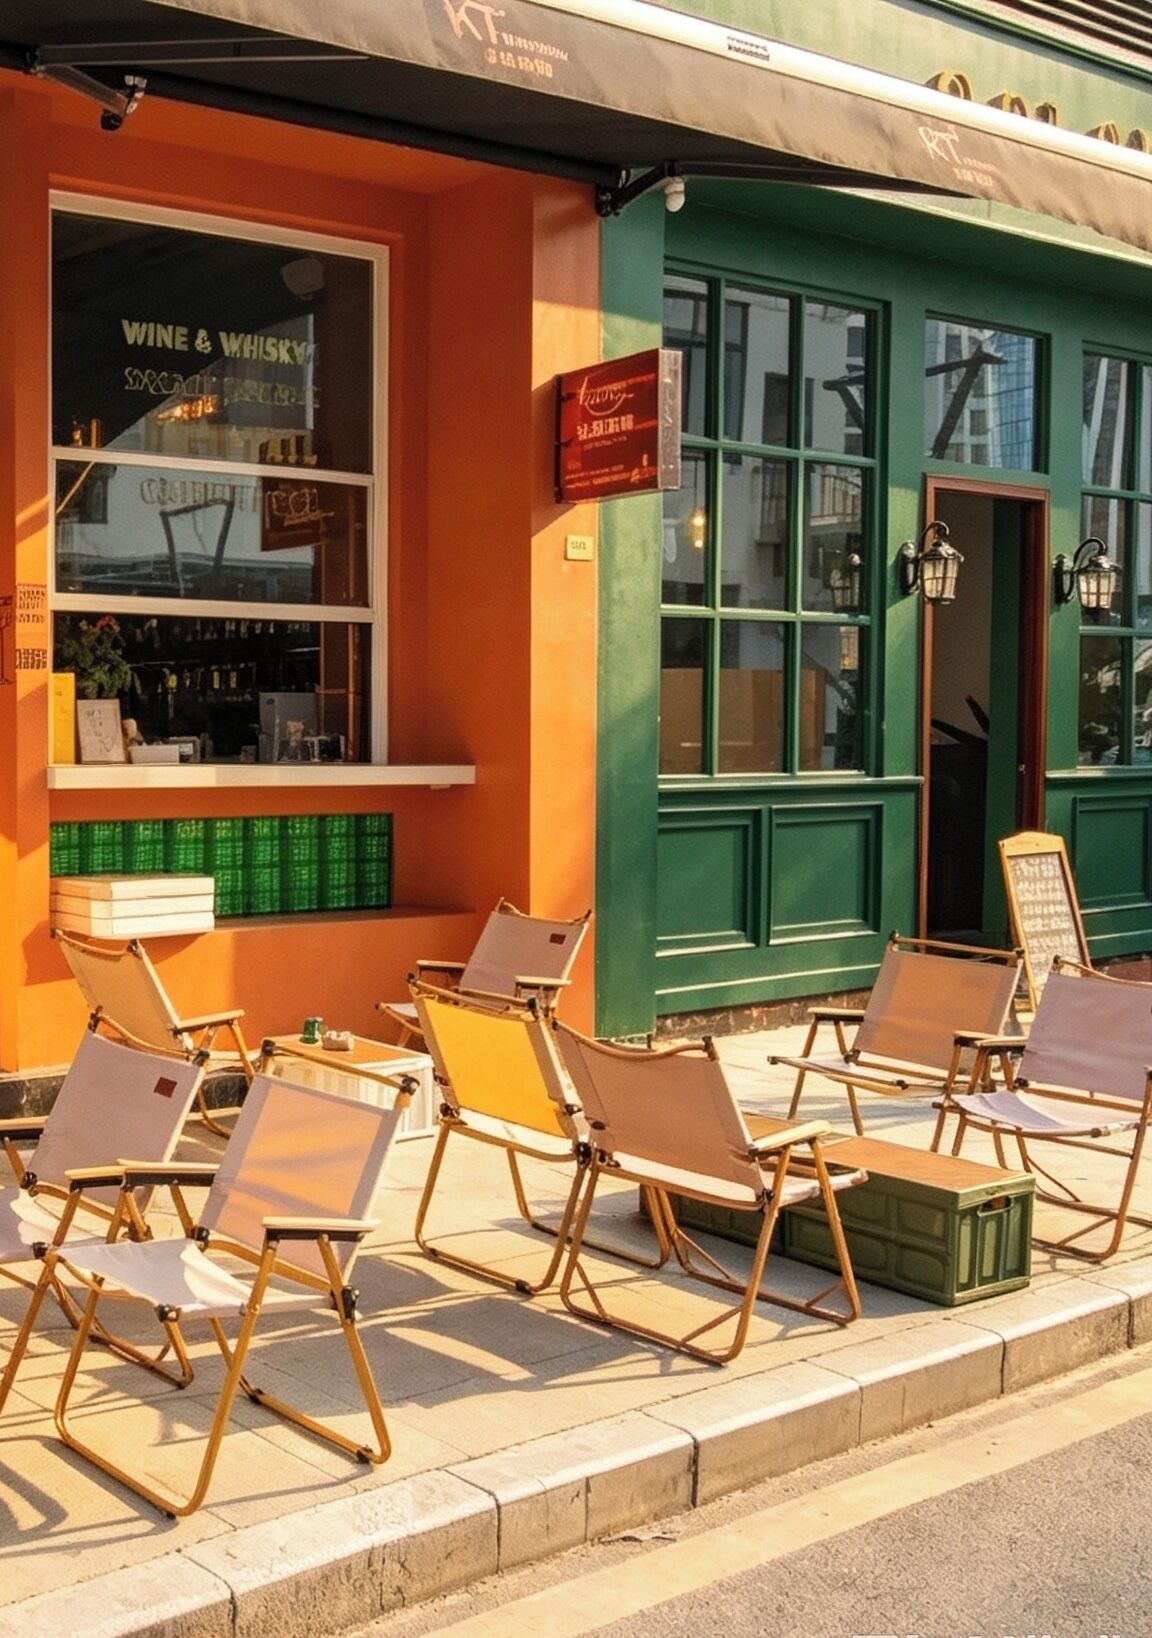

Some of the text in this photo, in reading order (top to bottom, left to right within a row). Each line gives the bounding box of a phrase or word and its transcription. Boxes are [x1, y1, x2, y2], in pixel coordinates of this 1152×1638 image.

[121, 319, 308, 365] WINE & WHISKY
